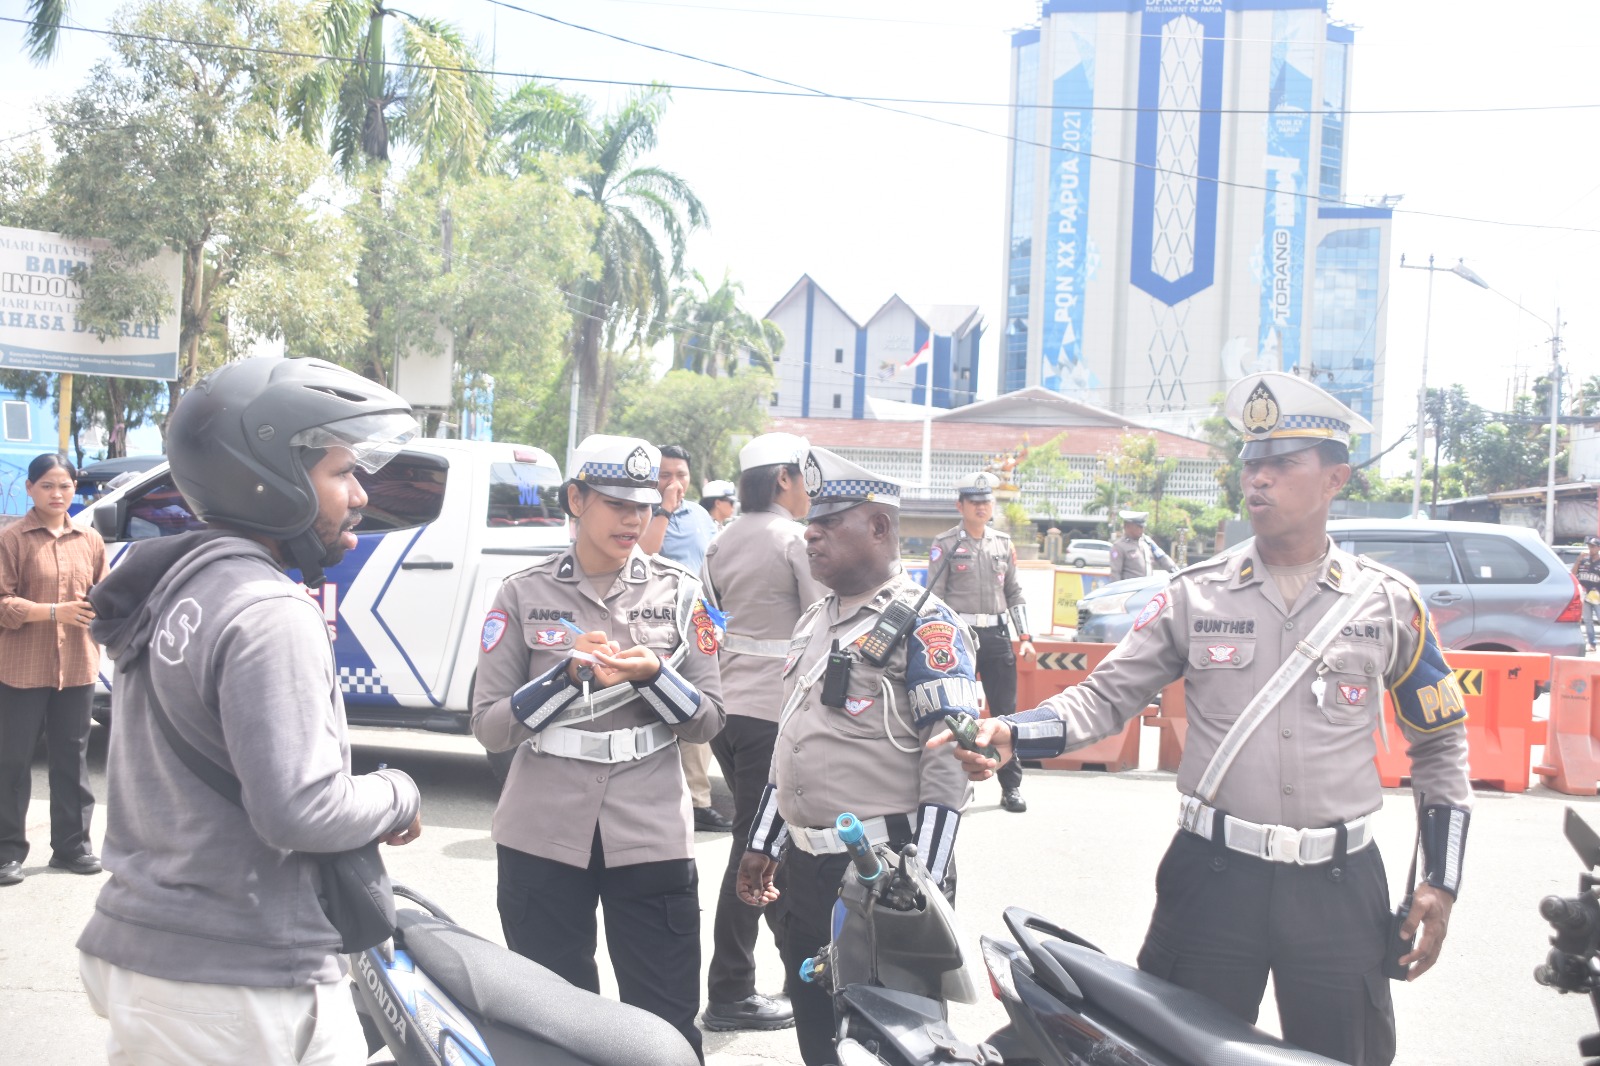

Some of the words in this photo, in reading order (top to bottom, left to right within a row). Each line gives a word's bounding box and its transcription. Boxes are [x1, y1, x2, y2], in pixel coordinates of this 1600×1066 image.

[1062, 111, 1081, 153] 2021
[1059, 158, 1080, 235] PAPUA
[38, 242, 68, 256] KITA
[1057, 241, 1075, 270] XX
[1275, 231, 1288, 319] TORANG
[34, 300, 63, 313] KITA
[527, 608, 576, 623] ANGEL
[629, 606, 676, 621] POLRI
[1193, 619, 1254, 634] GUNTHER
[1341, 624, 1380, 640] OLRI
[357, 950, 408, 1044] HONDA
